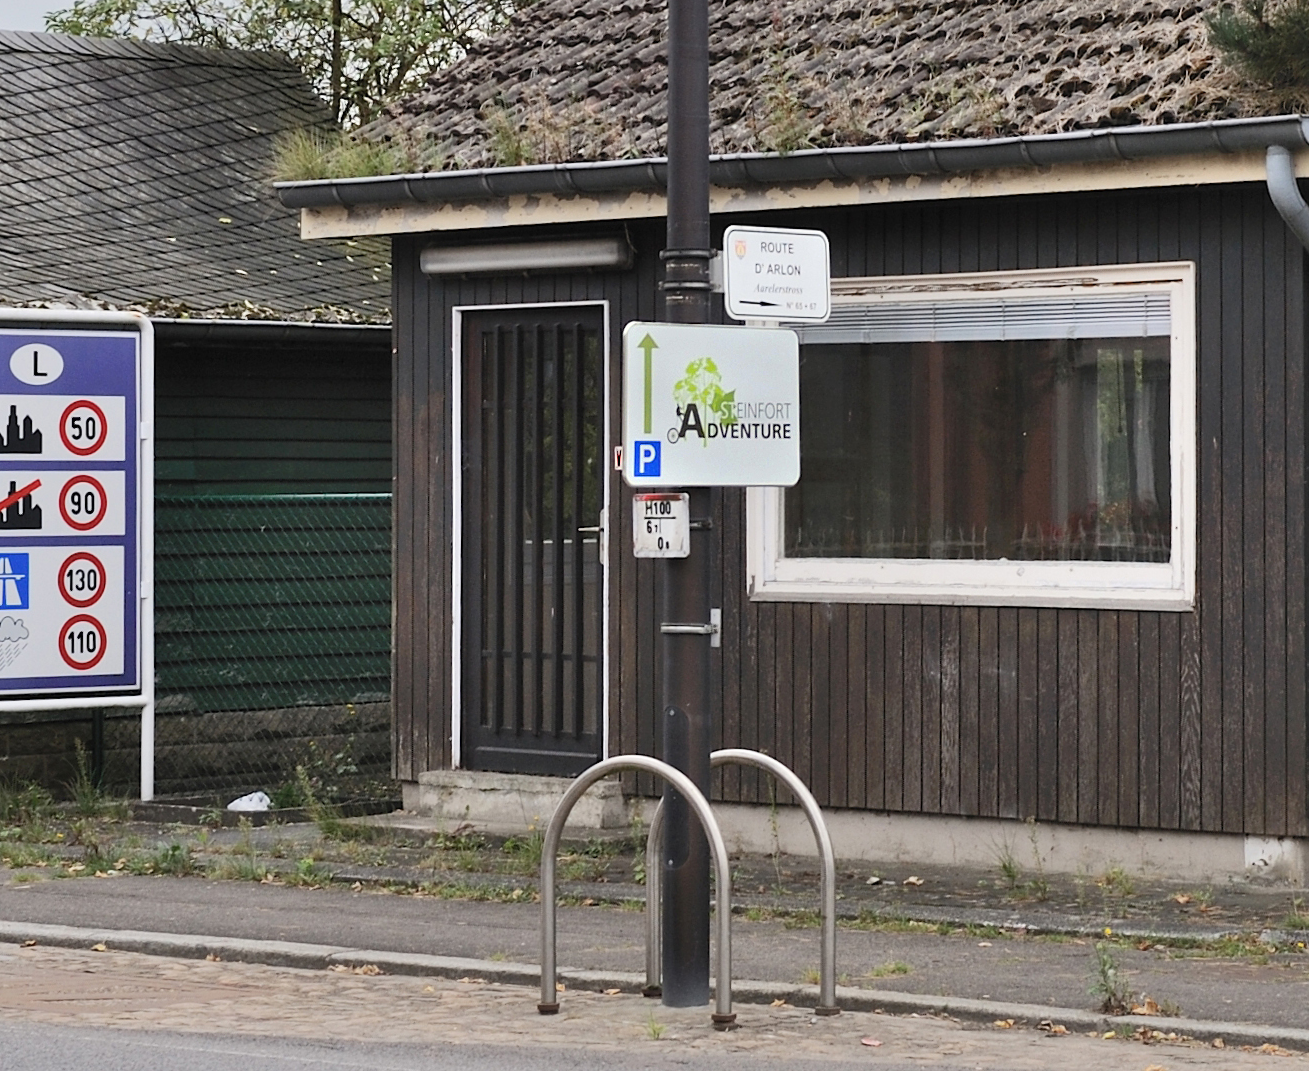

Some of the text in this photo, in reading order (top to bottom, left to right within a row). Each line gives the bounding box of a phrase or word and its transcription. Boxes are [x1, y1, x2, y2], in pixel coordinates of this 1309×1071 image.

[760, 241, 794, 254] ROUTE
[767, 264, 801, 276] ARLON
[32, 350, 48, 377] L
[678, 403, 792, 439] ADVENTURE
[720, 401, 792, 419] STEINFORT
[70, 416, 96, 441] 50
[639, 443, 656, 474] P
[70, 491, 96, 516] 90
[645, 501, 672, 515] H100
[66, 568, 98, 592] 130
[67, 630, 97, 654] 110
